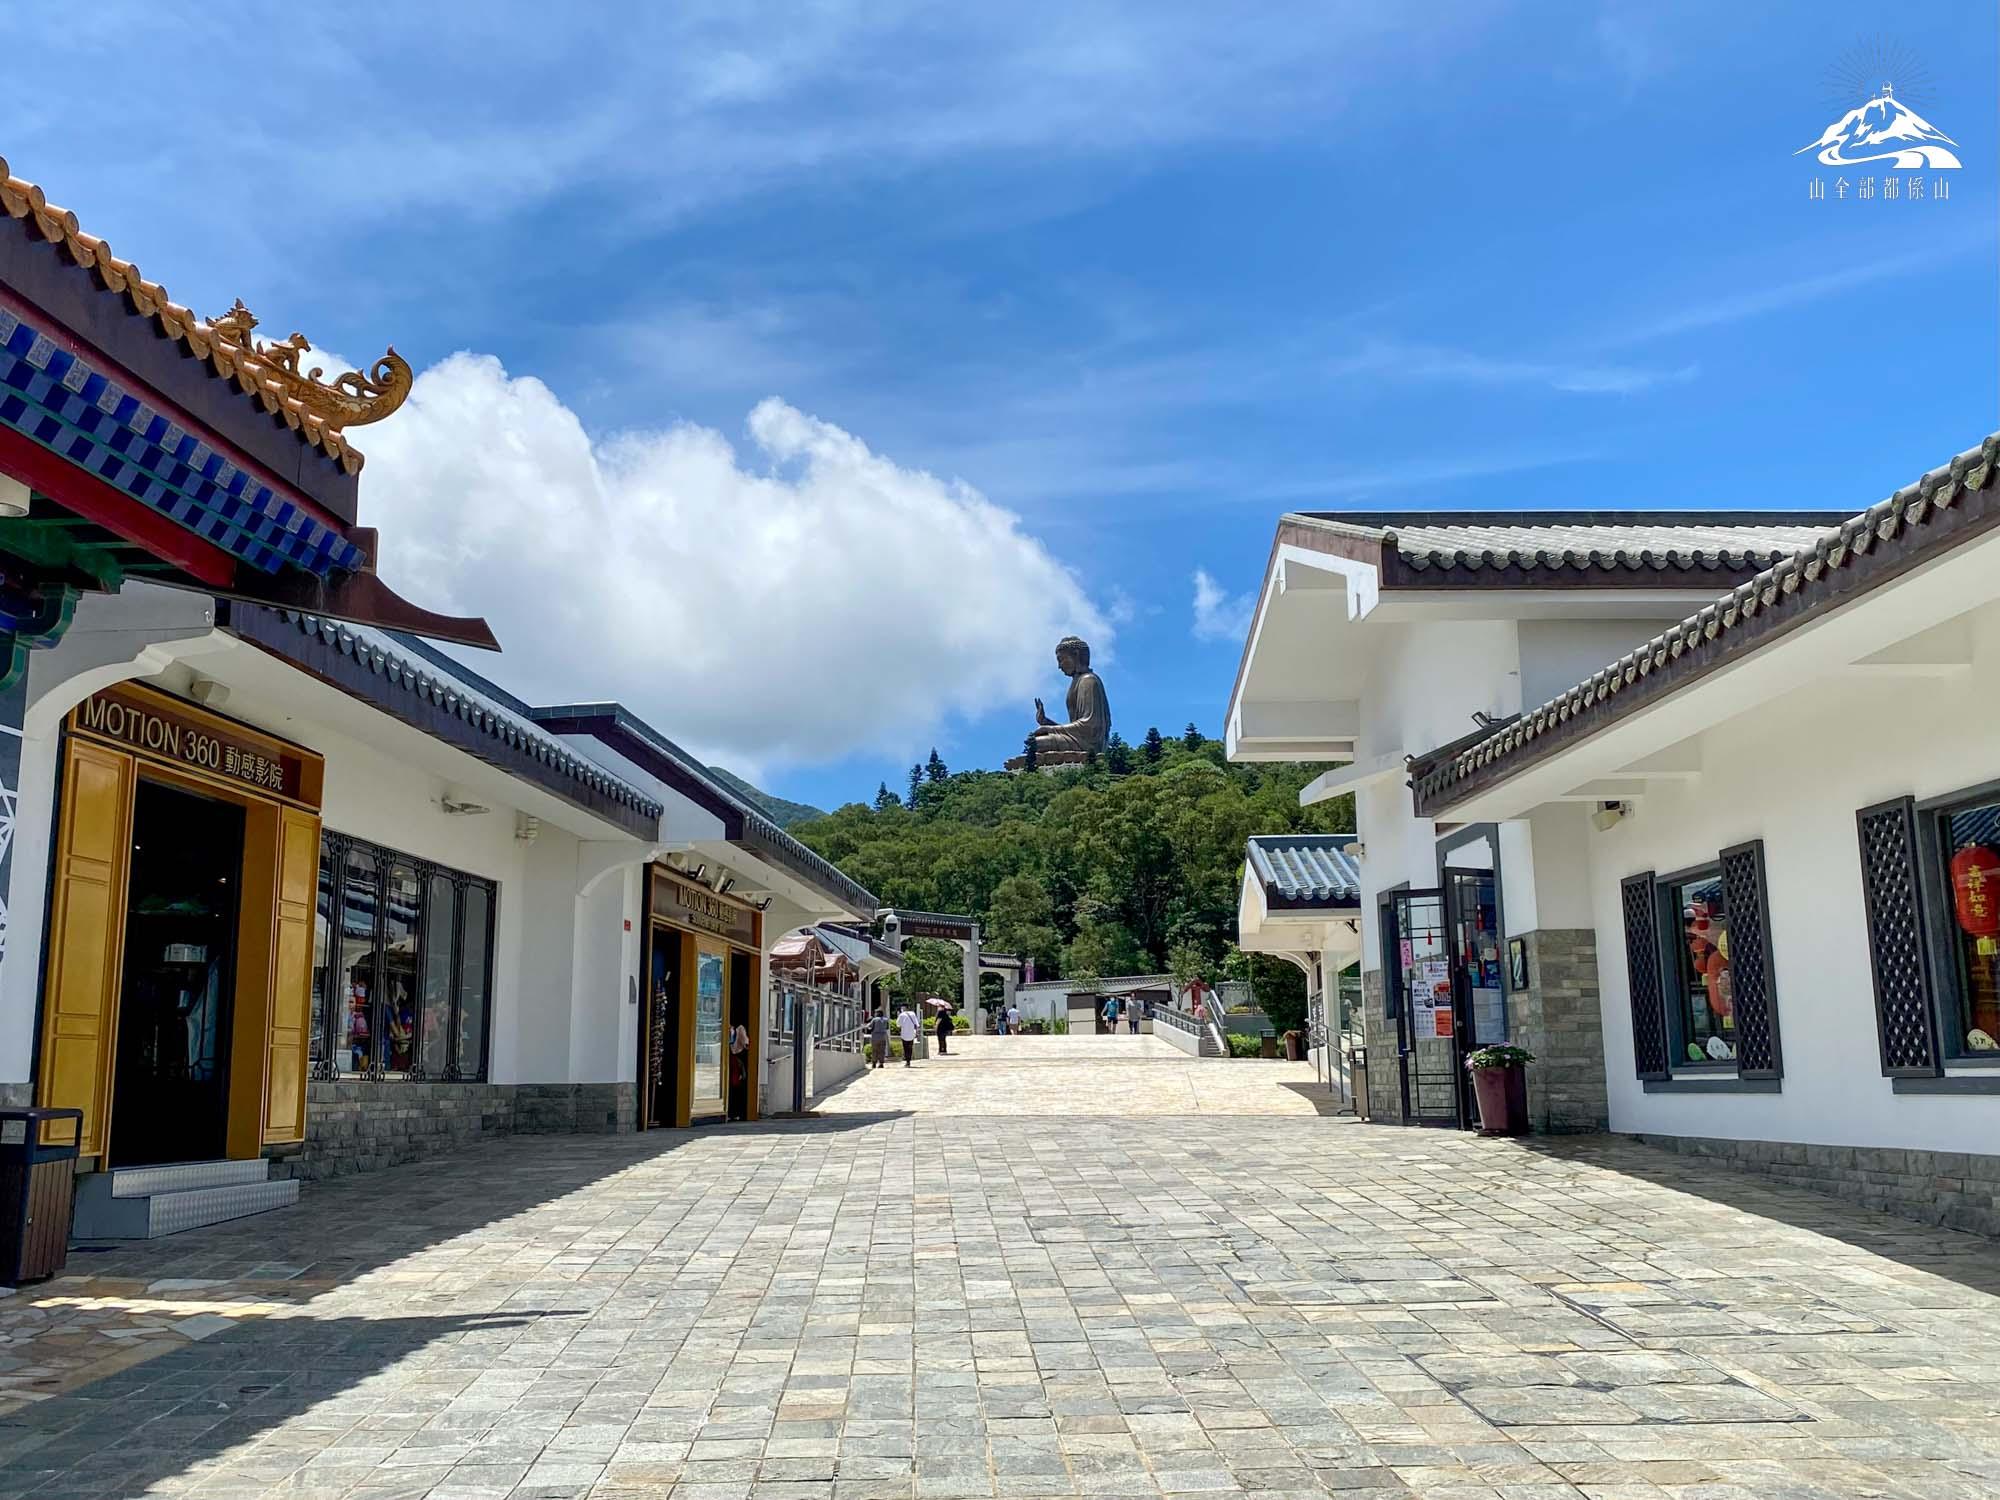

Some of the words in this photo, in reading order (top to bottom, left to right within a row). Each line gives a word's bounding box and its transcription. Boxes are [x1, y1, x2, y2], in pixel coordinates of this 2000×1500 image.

[85, 697, 180, 755] MOTION
[184, 731, 220, 768] 360
[224, 745, 284, 790] 動感影院
